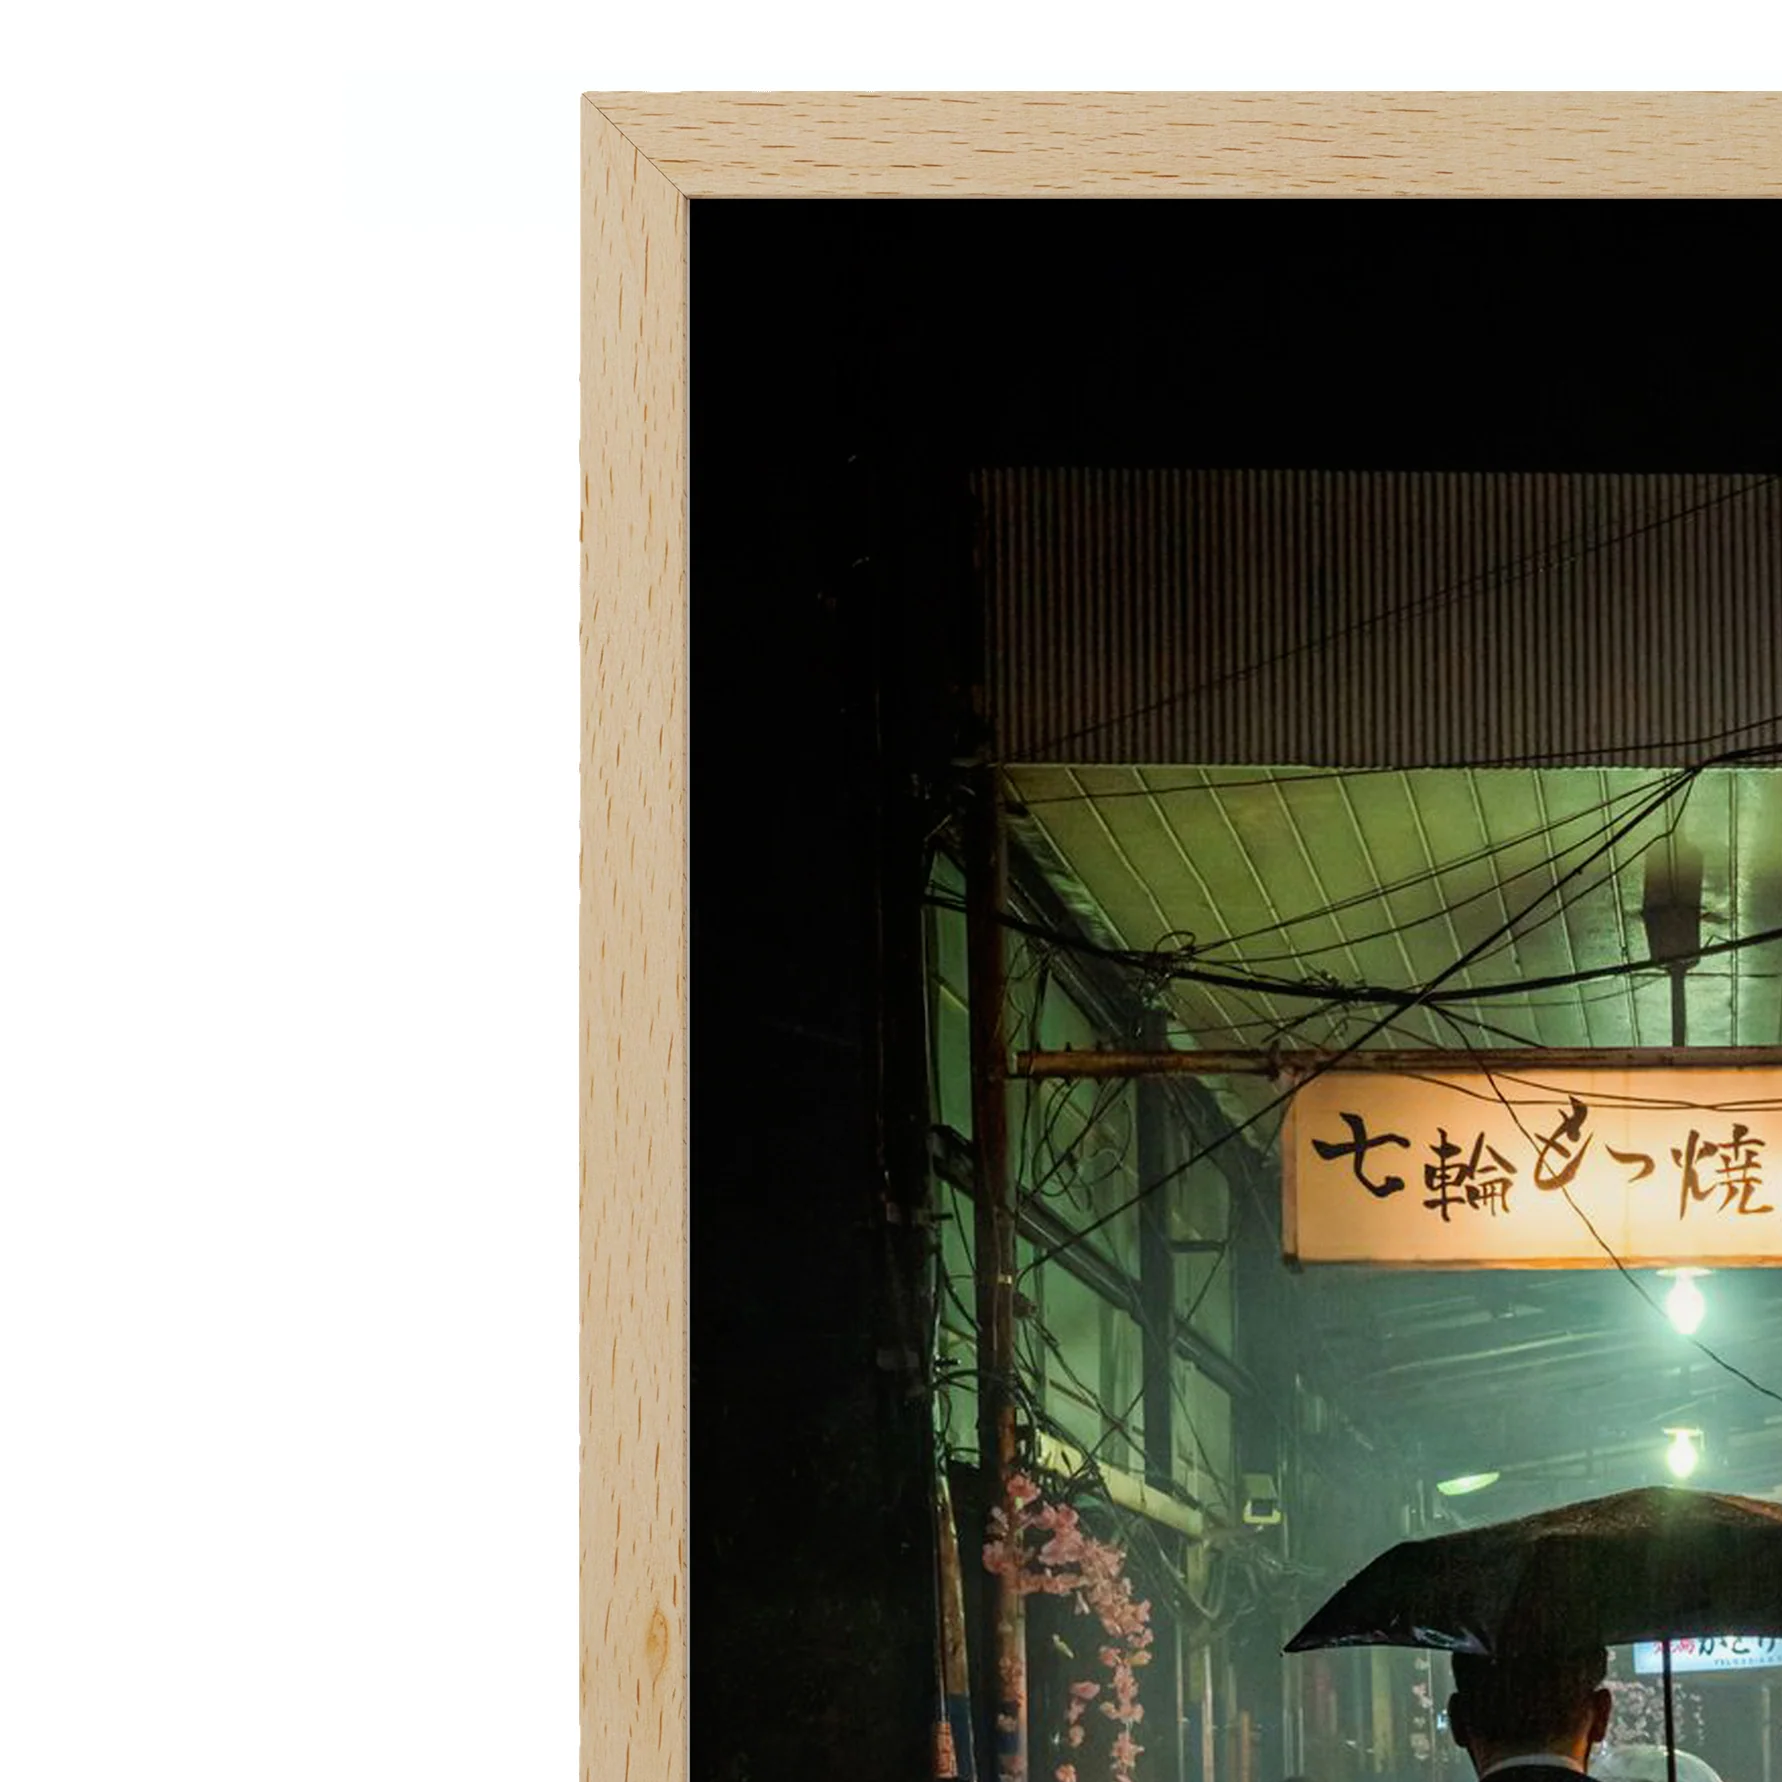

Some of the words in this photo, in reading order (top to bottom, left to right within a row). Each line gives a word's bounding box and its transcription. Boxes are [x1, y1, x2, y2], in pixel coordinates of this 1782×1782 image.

[1311, 1095, 1774, 1222] 七輪もつ焼
